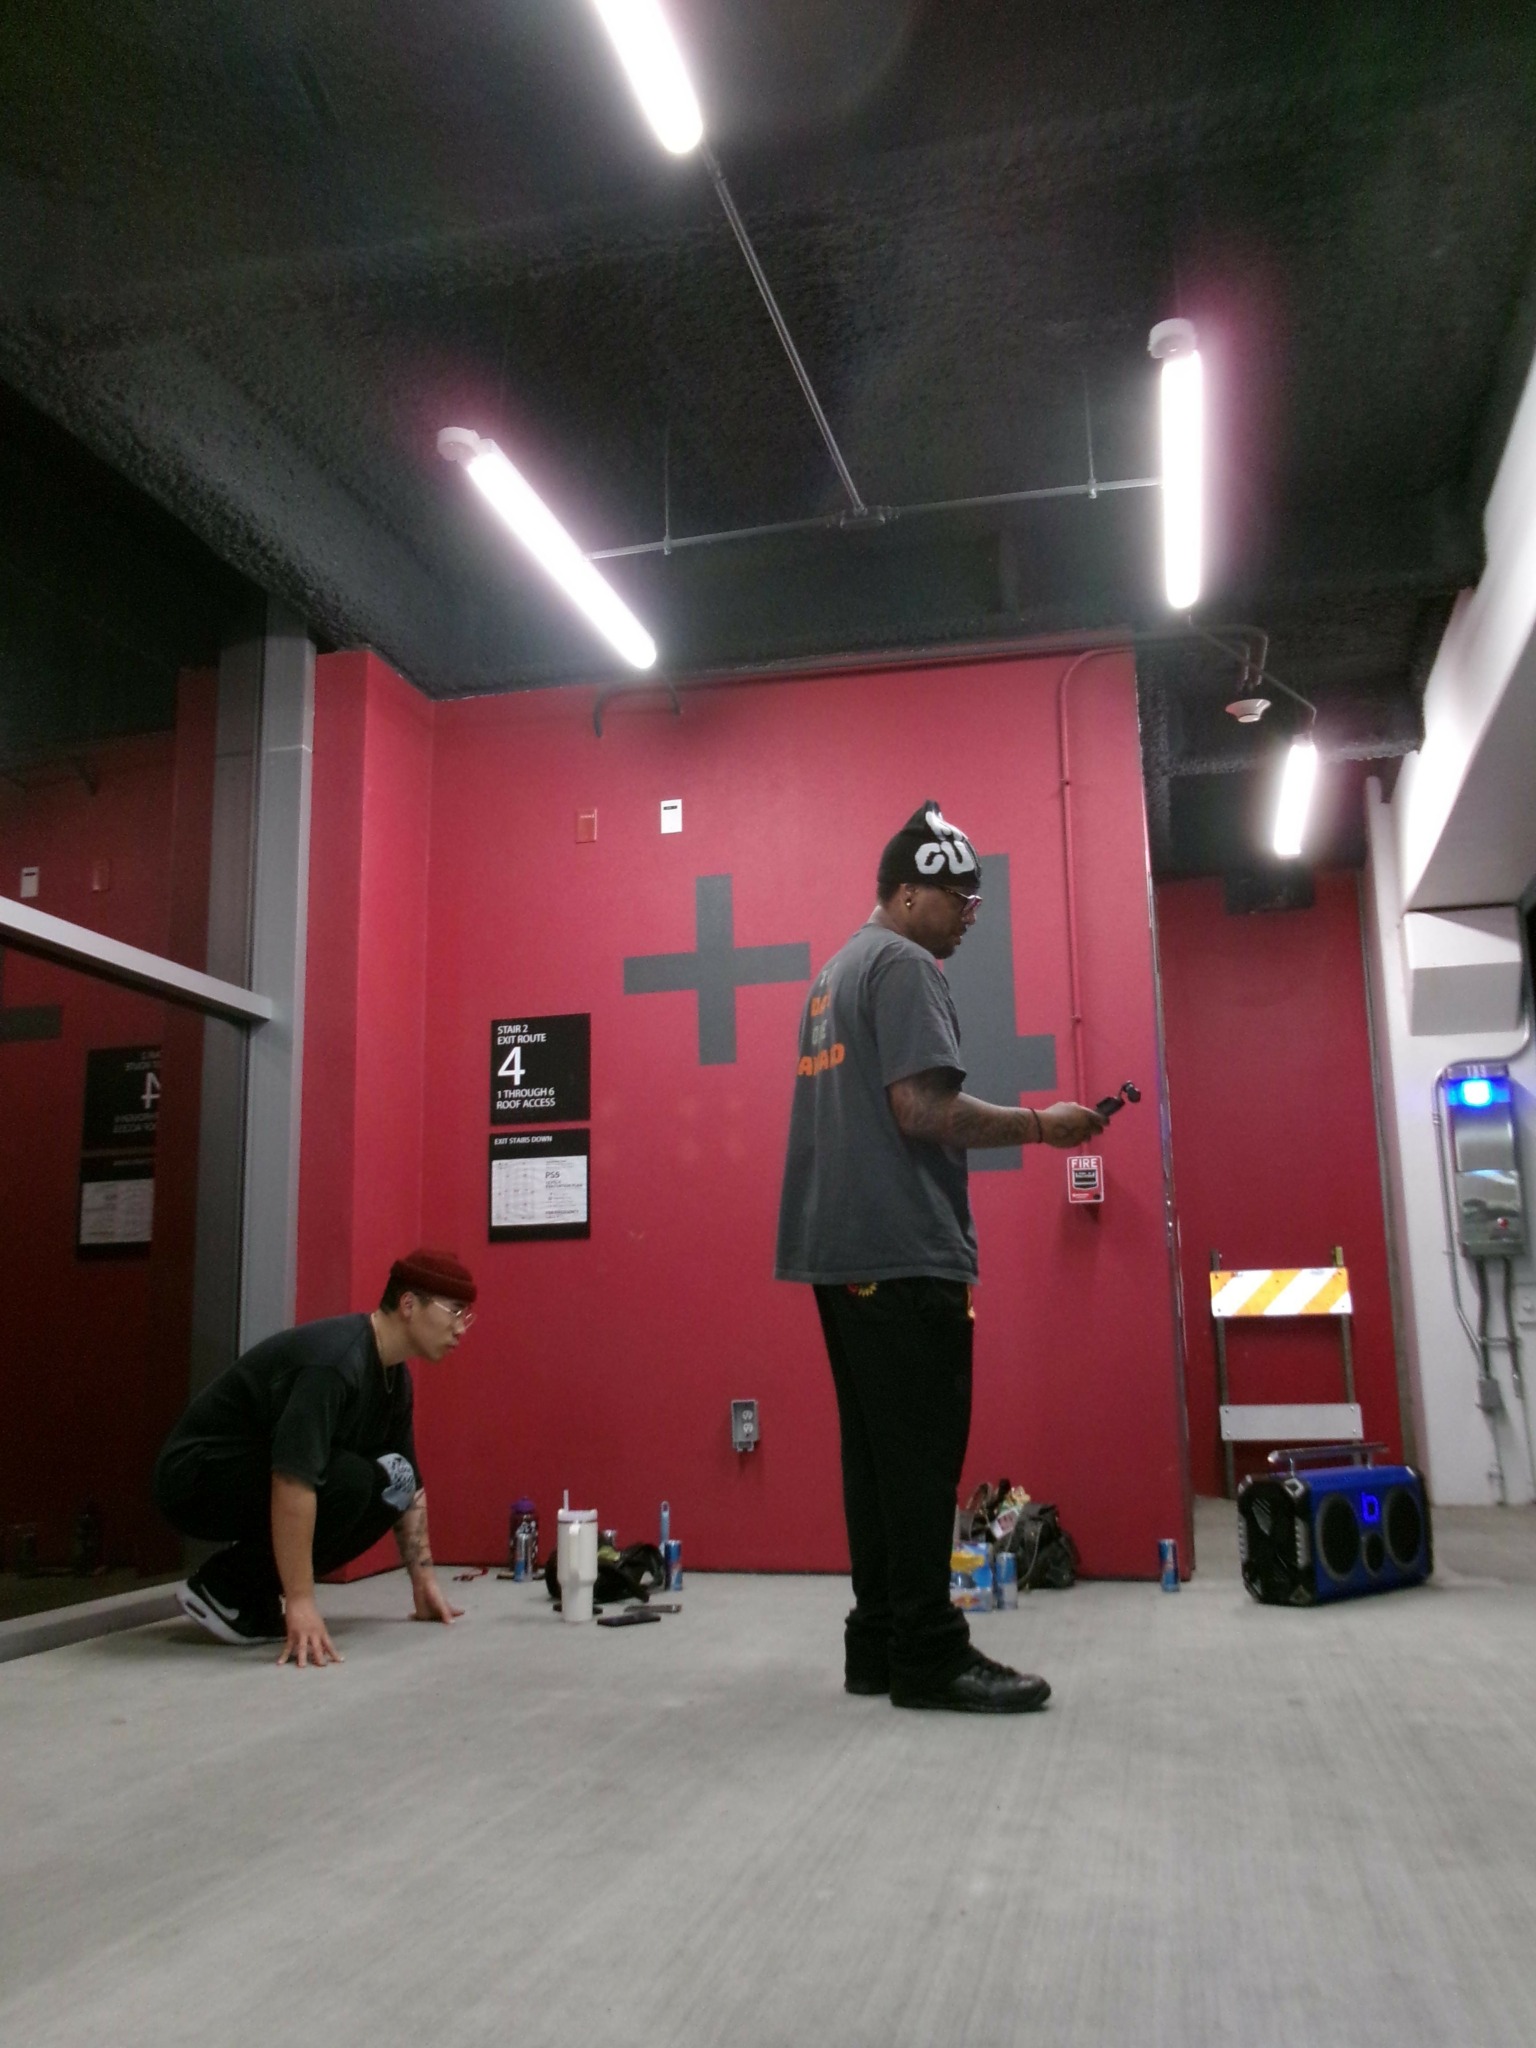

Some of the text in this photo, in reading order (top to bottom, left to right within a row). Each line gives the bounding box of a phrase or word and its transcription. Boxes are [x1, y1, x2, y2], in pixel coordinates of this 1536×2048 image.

[497, 1024, 529, 1035] STAIR 2
[497, 1033, 547, 1045] EXIT ROUTE
[497, 1046, 526, 1086] 4
[497, 1087, 555, 1099] 1 THROUGH 6
[496, 1098, 556, 1109] ROOF ACCESS
[494, 1138, 508, 1146] EXIT
[1071, 1158, 1098, 1168] FIRE
